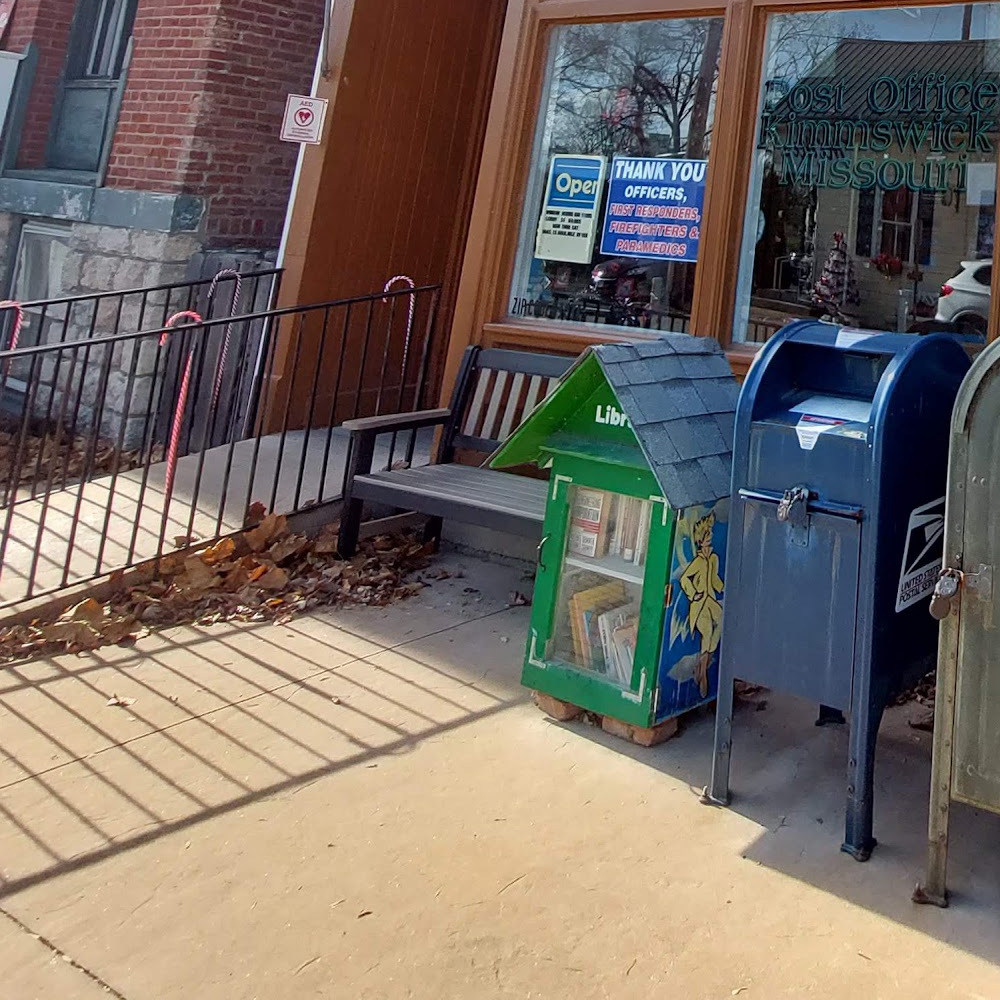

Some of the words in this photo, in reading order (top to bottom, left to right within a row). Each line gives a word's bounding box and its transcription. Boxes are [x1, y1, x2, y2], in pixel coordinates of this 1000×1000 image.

[764, 77, 847, 113] Post
[867, 73, 1000, 114] Office
[757, 110, 995, 152] Kimmswick
[615, 161, 666, 181] THANK
[671, 162, 706, 182] YOU
[779, 151, 969, 193] Missouri
[624, 185, 688, 203] OFFICERS,
[609, 203, 635, 217] FIRST
[635, 205, 701, 222] RESPONDERS,
[609, 221, 687, 238] FIREFIGHTERS
[688, 225, 700, 239] &
[615, 239, 688, 257] PARAMEDICS
